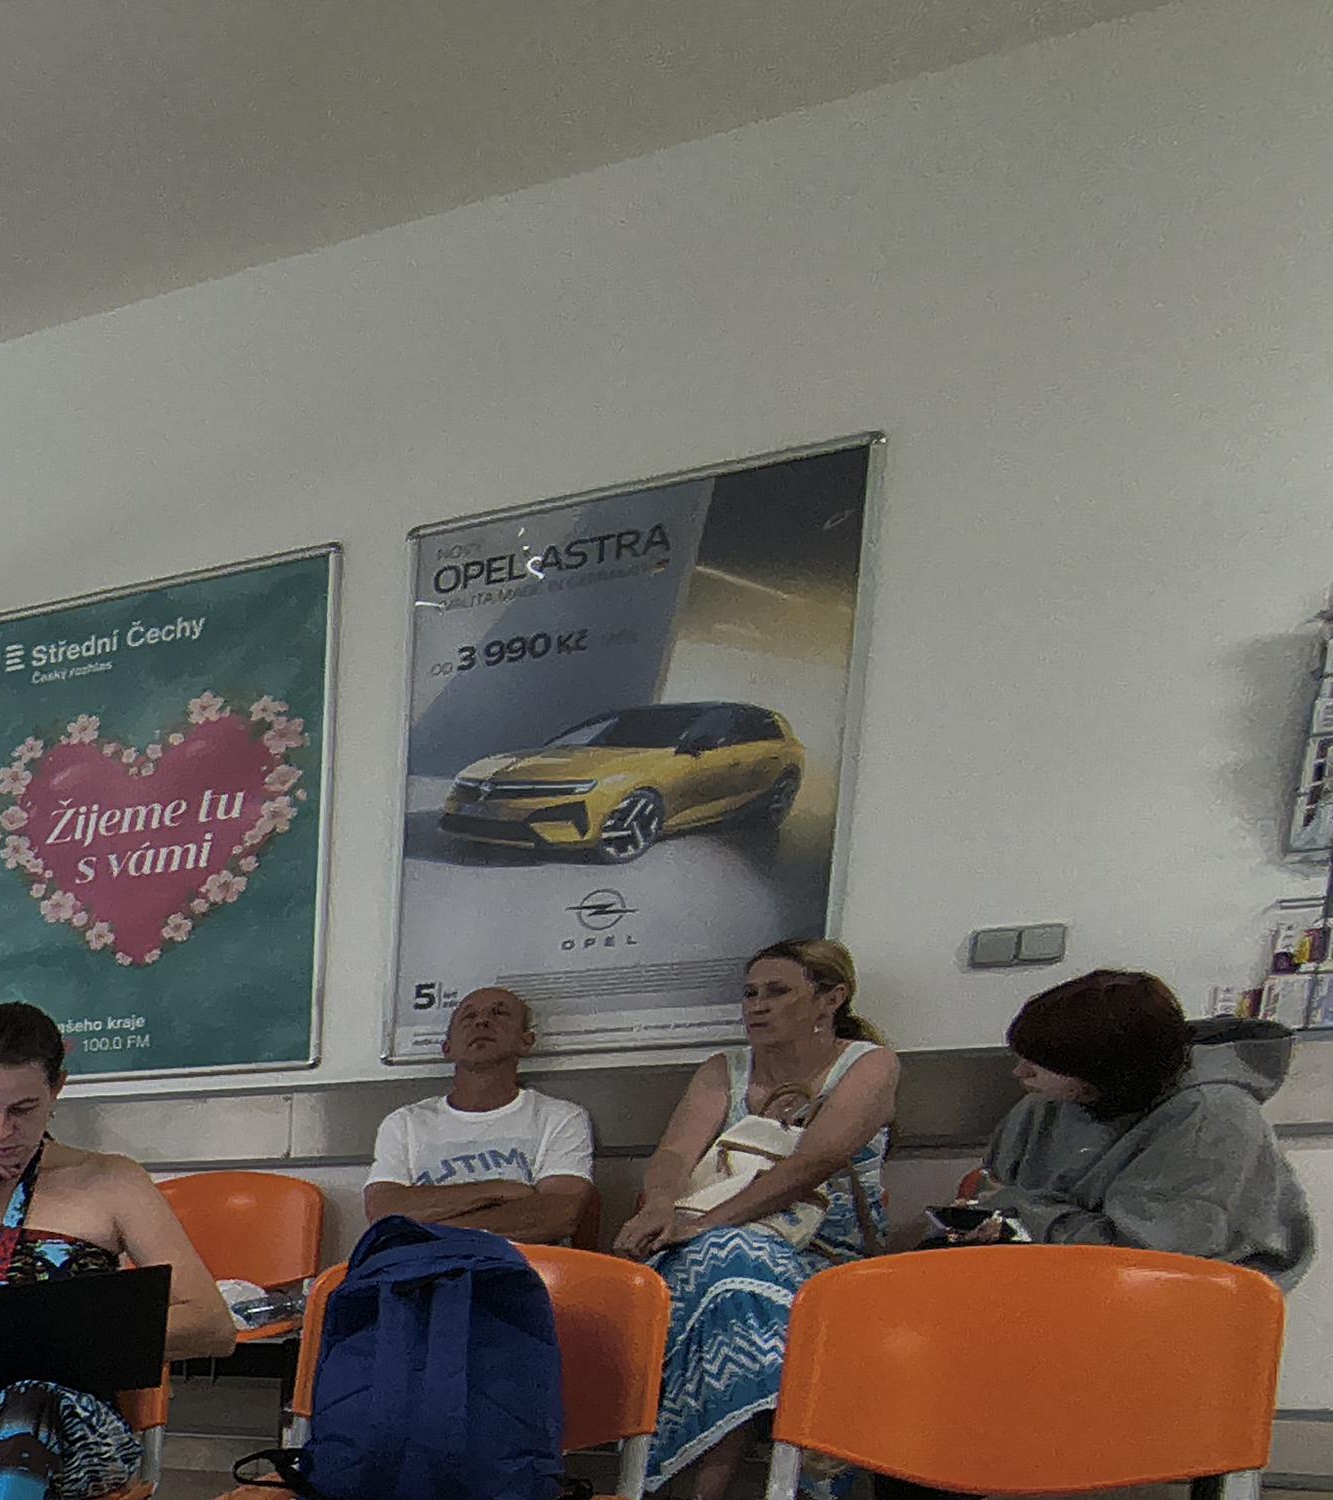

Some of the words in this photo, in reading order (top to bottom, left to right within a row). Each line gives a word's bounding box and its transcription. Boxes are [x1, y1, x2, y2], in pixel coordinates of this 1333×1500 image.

[434, 553, 527, 593] OPEL
[541, 523, 670, 571] ASTRA
[31, 629, 119, 667] Střední
[126, 616, 206, 648] Čechy
[457, 645, 477, 672] 3
[484, 632, 552, 667] 990
[45, 798, 187, 847] Žijeme
[198, 789, 246, 823] tu
[75, 856, 97, 884] s
[107, 832, 214, 879] vámi
[562, 934, 637, 950] OPEL
[414, 983, 436, 1010] 5
[57, 1018, 102, 1034] ašeho
[107, 1014, 146, 1031] kraje
[82, 1037, 122, 1052] 100.0
[126, 1034, 150, 1049] FM
